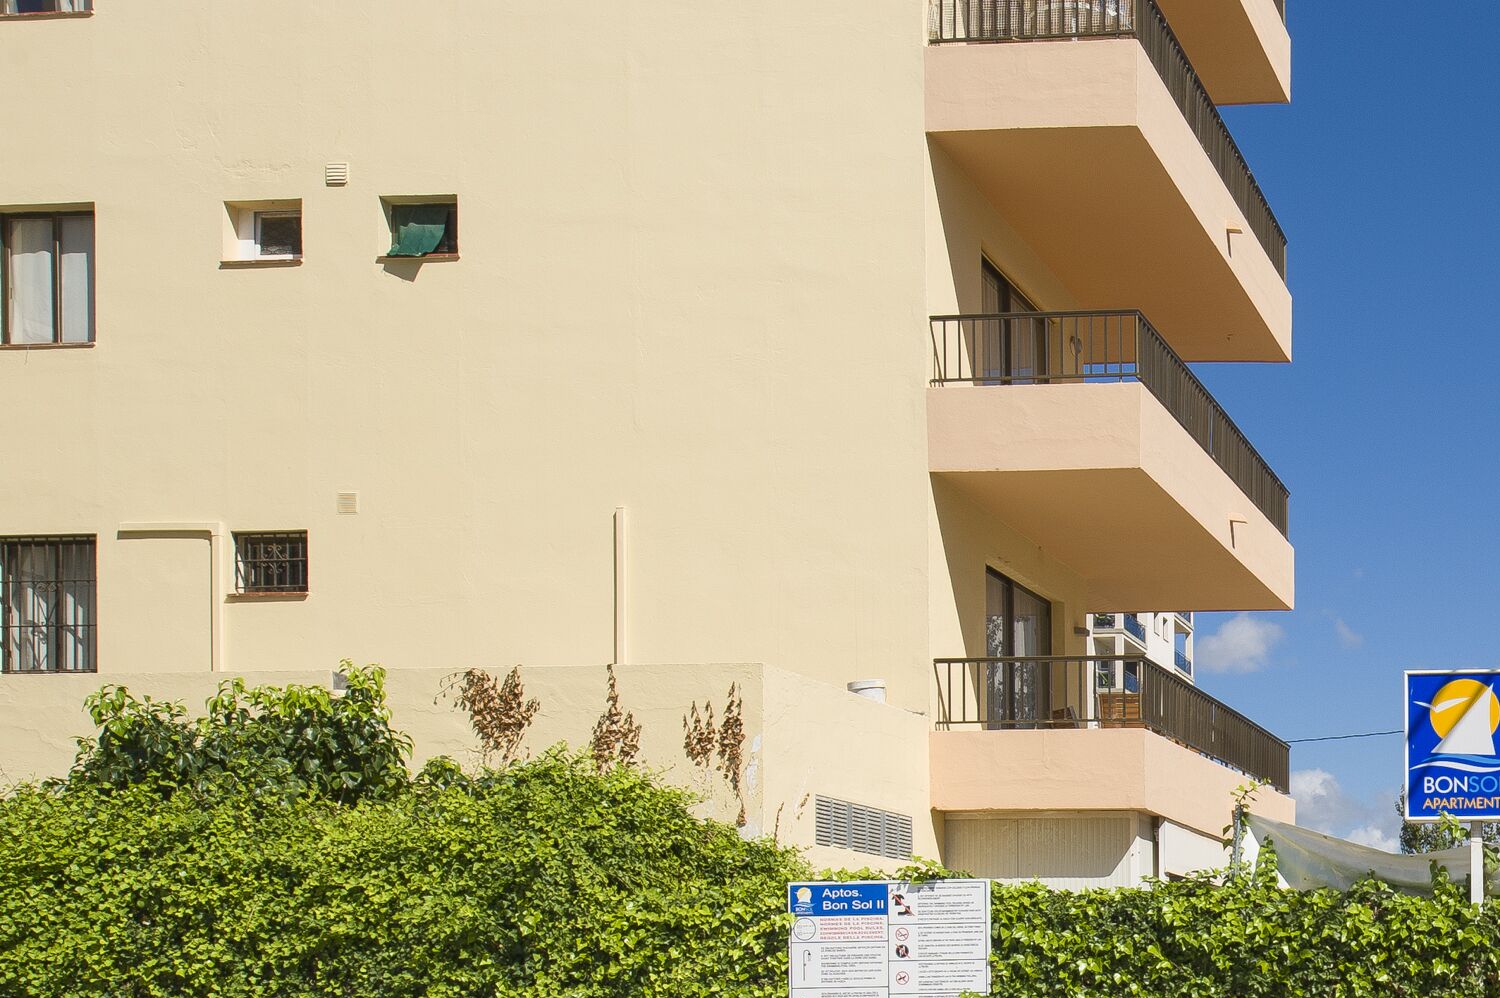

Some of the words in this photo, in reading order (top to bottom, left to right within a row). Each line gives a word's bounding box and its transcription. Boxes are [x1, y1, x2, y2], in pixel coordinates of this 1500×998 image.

[822, 888, 863, 899] Aptos.
[822, 901, 848, 910] Bon
[851, 899, 872, 909] Sol
